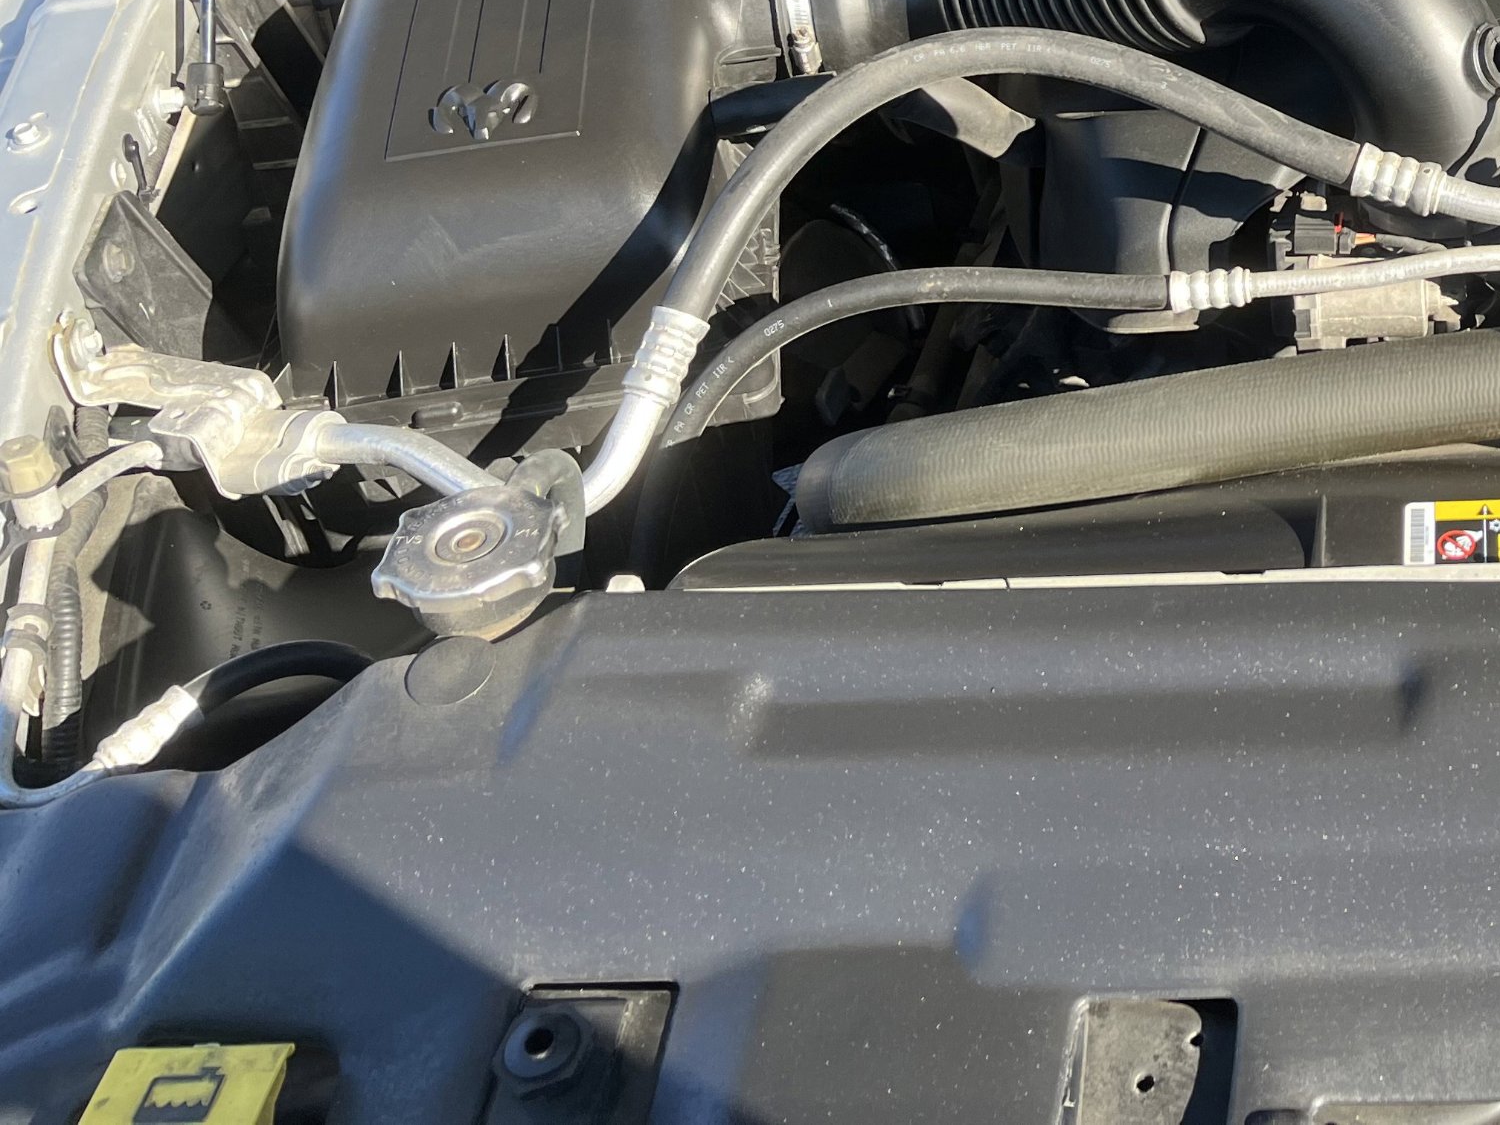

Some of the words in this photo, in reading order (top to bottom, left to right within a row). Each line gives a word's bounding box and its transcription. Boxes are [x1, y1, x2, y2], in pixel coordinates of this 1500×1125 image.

[1000, 43, 1018, 51] PET
[763, 319, 785, 337] 0275
[695, 382, 710, 398] PET
[395, 534, 424, 545] TVS
